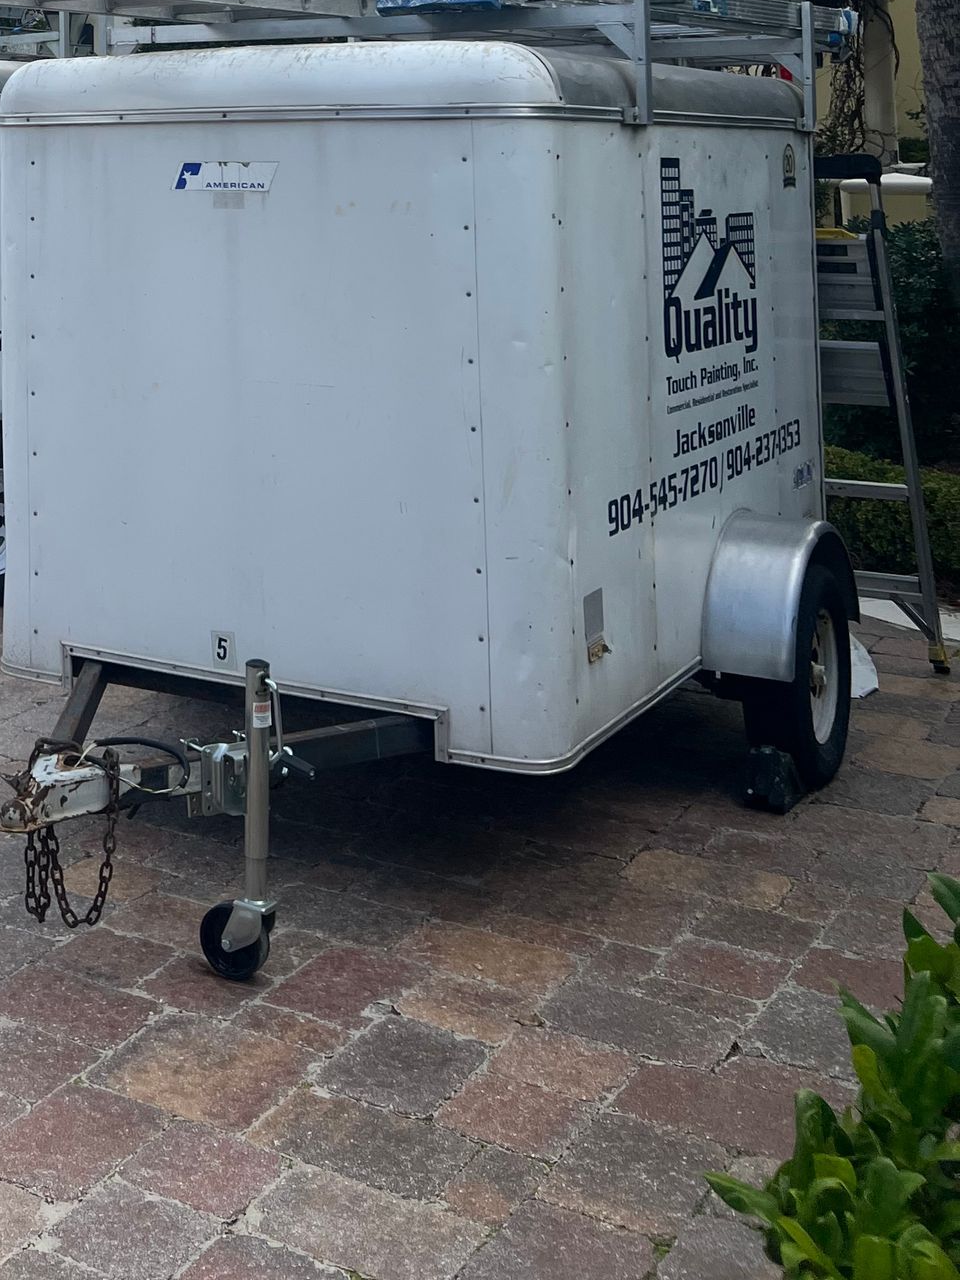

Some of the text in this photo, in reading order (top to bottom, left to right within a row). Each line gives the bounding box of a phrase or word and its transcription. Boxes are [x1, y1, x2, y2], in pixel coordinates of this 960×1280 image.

[663, 287, 758, 364] Quality
[666, 357, 759, 396] Touch Painting, Inc.
[673, 404, 756, 458] Jacksonville
[608, 456, 718, 537] 904-545-7270
[727, 419, 801, 481] 904-237-1353
[216, 636, 228, 661] 5
